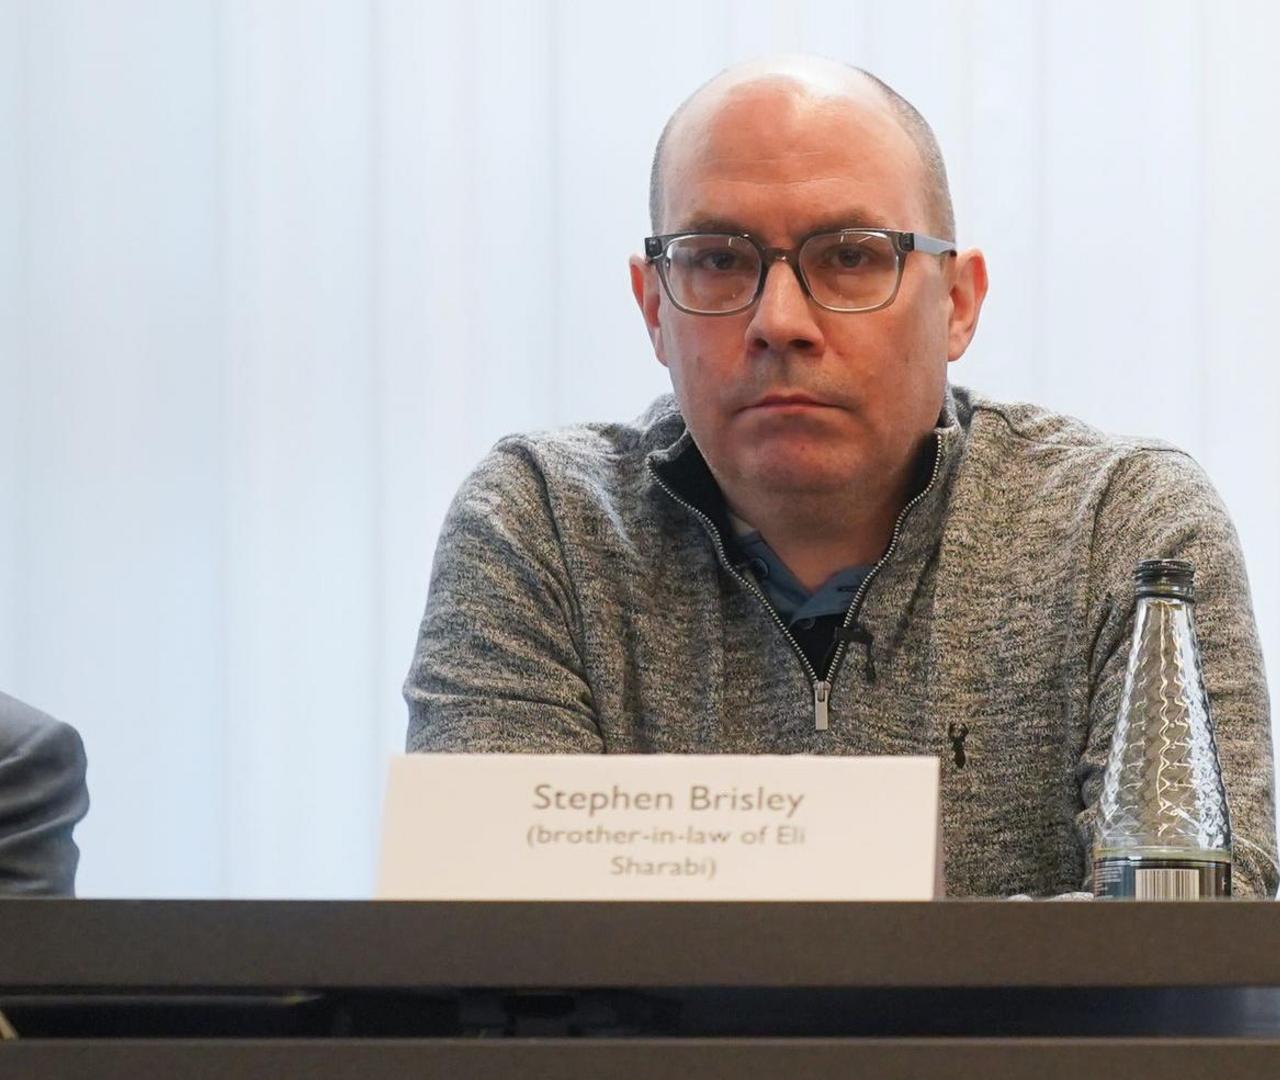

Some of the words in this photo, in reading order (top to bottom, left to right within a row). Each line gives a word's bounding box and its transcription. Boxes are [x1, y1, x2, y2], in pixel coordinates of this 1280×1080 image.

[532, 783, 674, 816] Stephen
[689, 784, 805, 817] Brisley
[526, 824, 731, 848] (brother-in-law
[740, 825, 768, 845] of
[776, 825, 805, 845] Eli
[610, 854, 717, 879] Sharabi)
